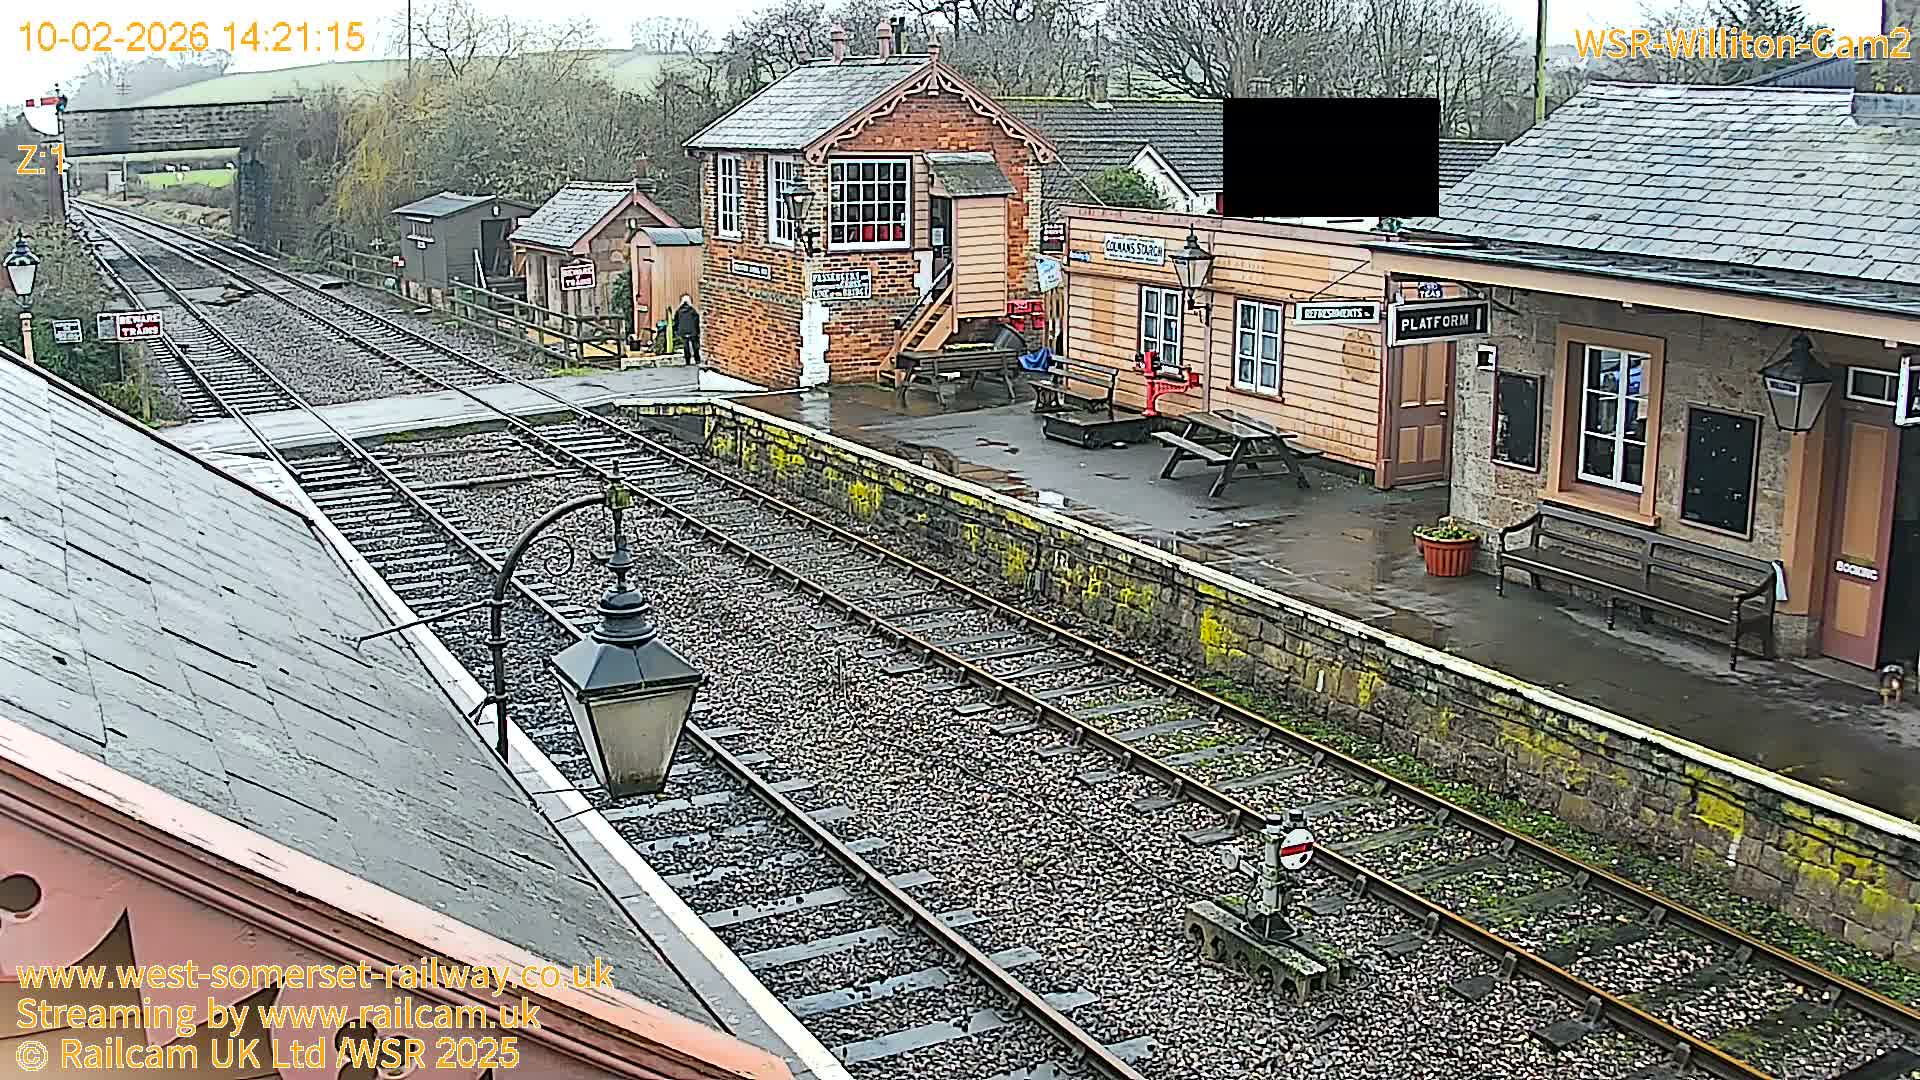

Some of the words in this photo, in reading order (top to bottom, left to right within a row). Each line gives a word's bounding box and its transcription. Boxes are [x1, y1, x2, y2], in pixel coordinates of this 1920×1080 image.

[1419, 289, 1441, 299] TEAS
[1303, 307, 1362, 319] REFRESHMENTS
[1401, 312, 1470, 332] PLATFORM
[1835, 560, 1879, 581] BOOKING
